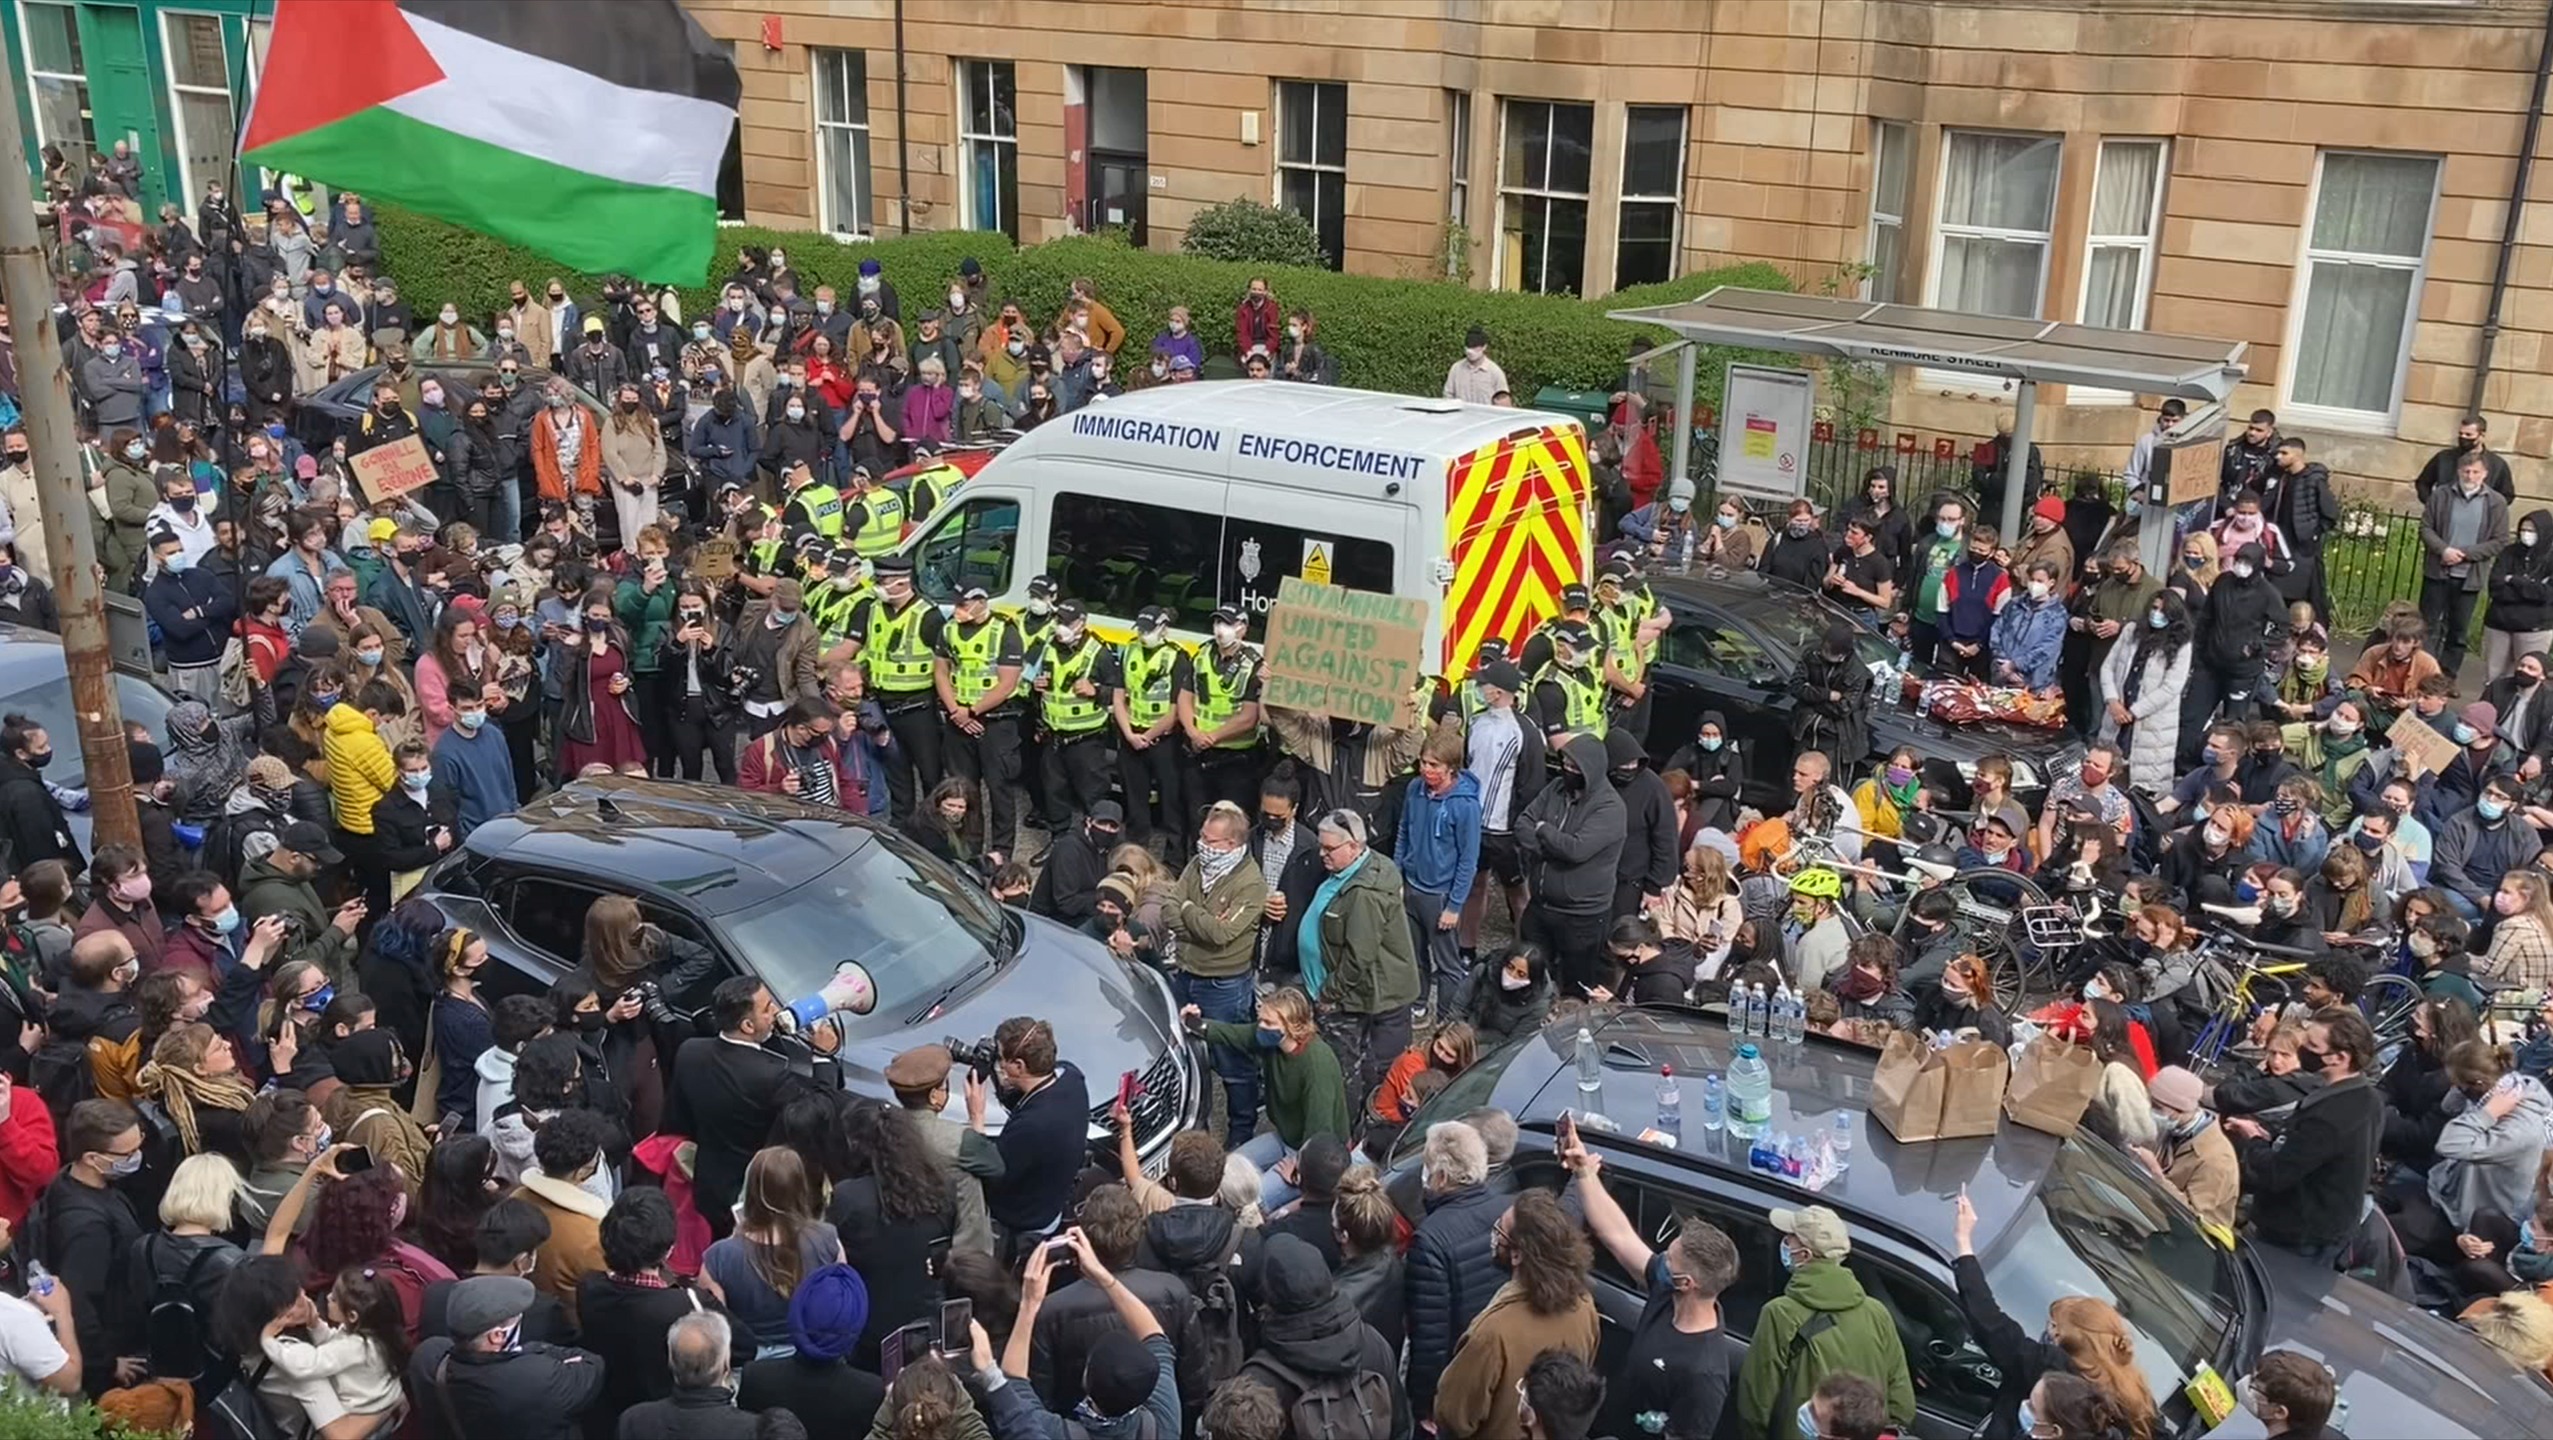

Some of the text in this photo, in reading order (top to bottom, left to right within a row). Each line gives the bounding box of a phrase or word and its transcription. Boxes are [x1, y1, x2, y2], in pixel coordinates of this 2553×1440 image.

[1072, 413, 1426, 480] IMMIGRATION ENFORCEMENT
[1281, 611, 1377, 650] UNITED
[1273, 641, 1408, 692] AGAINST
[1267, 674, 1395, 724] EVICTION
